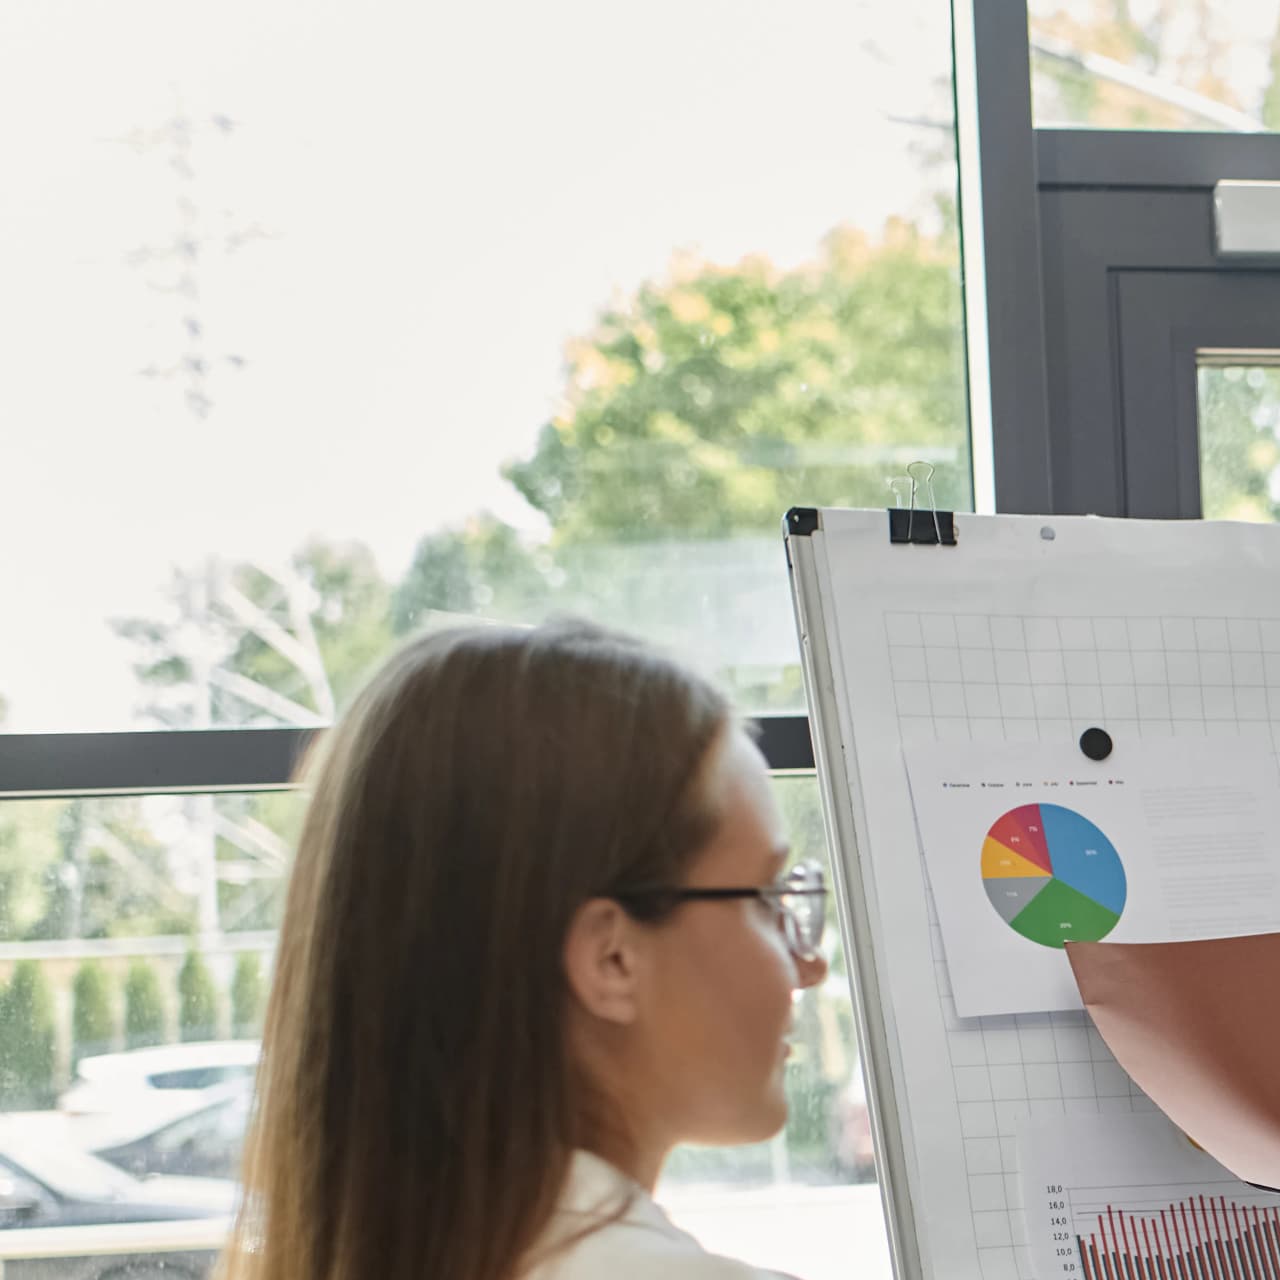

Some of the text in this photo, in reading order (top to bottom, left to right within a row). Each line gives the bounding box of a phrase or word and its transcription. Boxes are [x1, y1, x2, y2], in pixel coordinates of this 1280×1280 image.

[1046, 1185, 1062, 1193] 18,0
[1048, 1201, 1064, 1209] 16,0
[1050, 1217, 1066, 1225] 14,0
[1053, 1232, 1069, 1240] 12,0
[1056, 1248, 1072, 1256] 10,0
